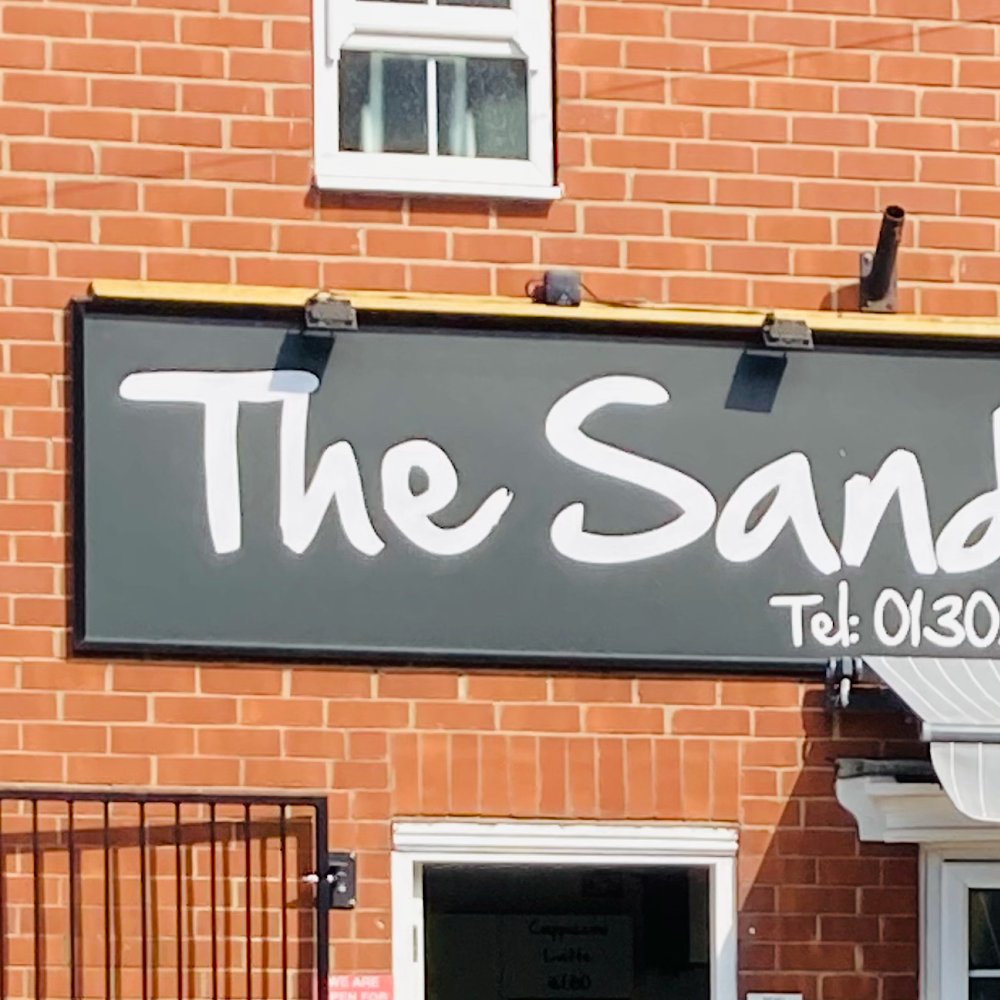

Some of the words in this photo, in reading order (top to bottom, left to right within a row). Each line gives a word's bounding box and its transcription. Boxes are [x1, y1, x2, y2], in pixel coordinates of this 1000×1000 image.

[119, 370, 514, 556] The
[769, 580, 860, 648] Tel:
[352, 976, 380, 988] ARE
